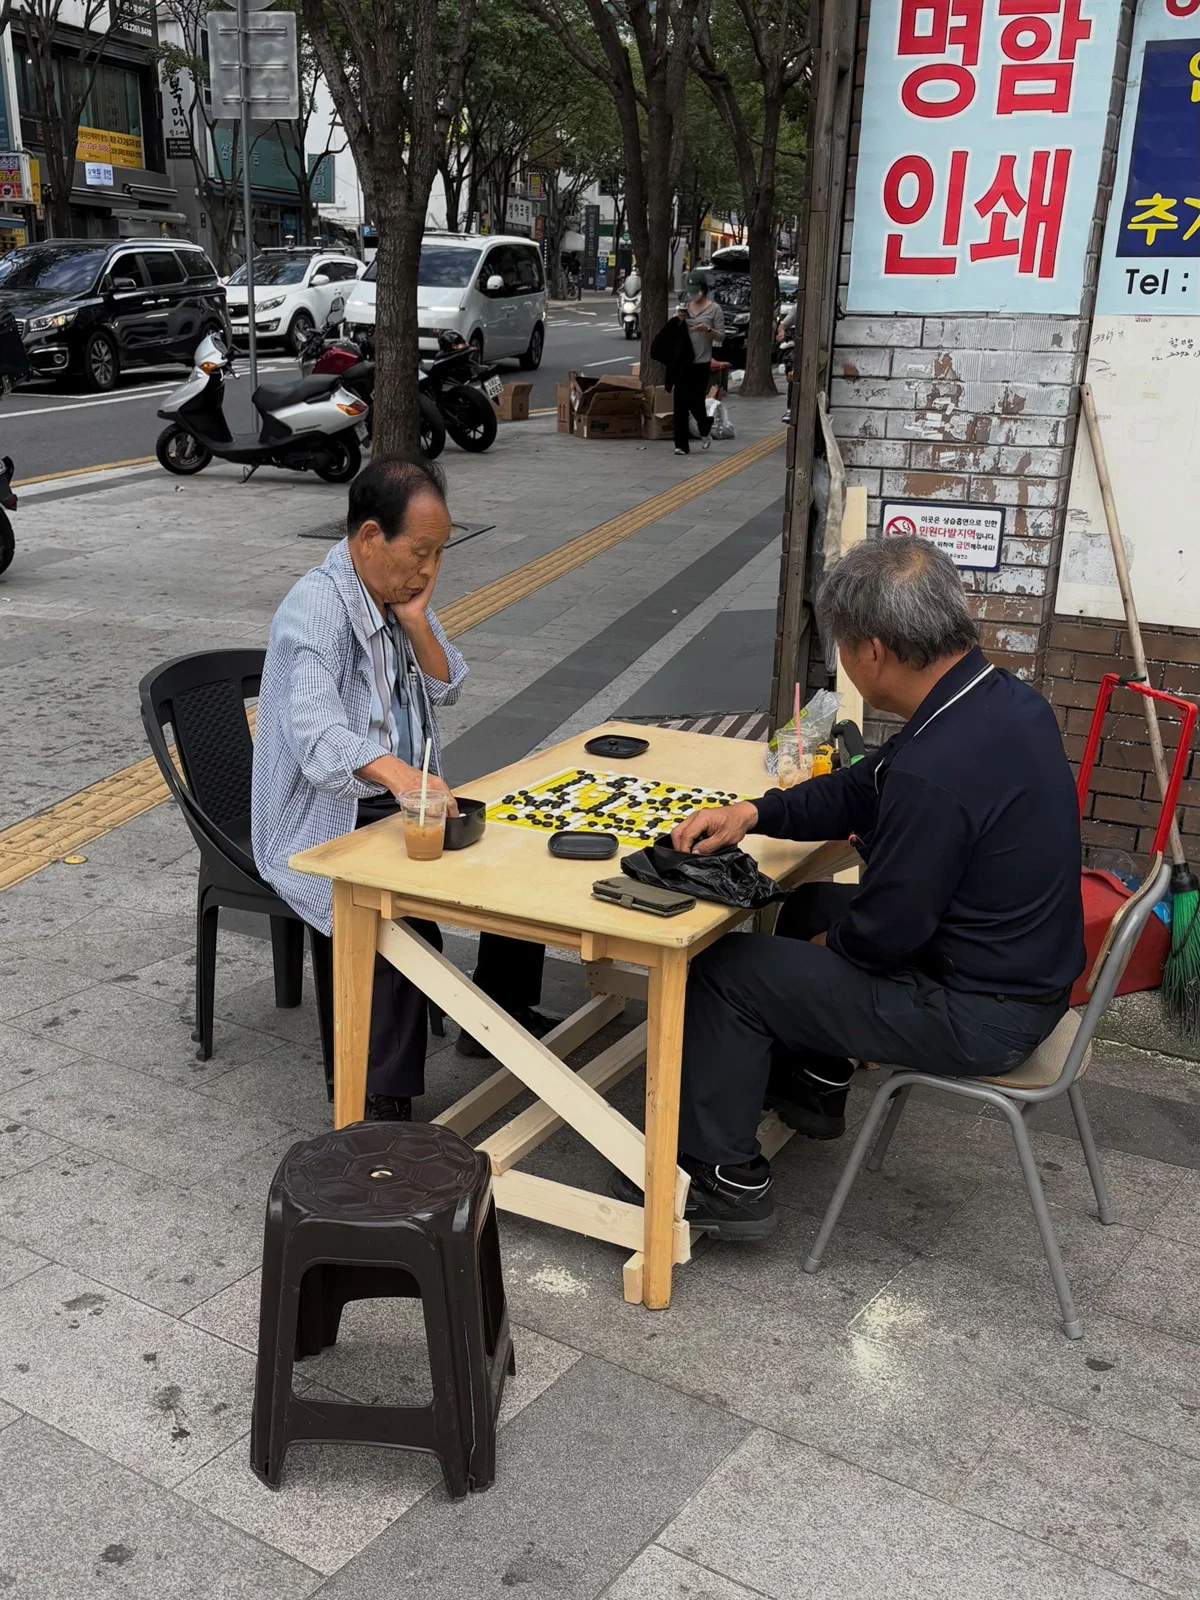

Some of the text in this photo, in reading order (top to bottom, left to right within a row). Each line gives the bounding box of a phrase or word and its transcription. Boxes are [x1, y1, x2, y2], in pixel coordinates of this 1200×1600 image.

[897, 0, 1093, 118] 명함
[883, 148, 1073, 278] 인쇄
[1125, 268, 1169, 295] Tel
[921, 515, 998, 528] 이곳은 상습흡연으로 인한
